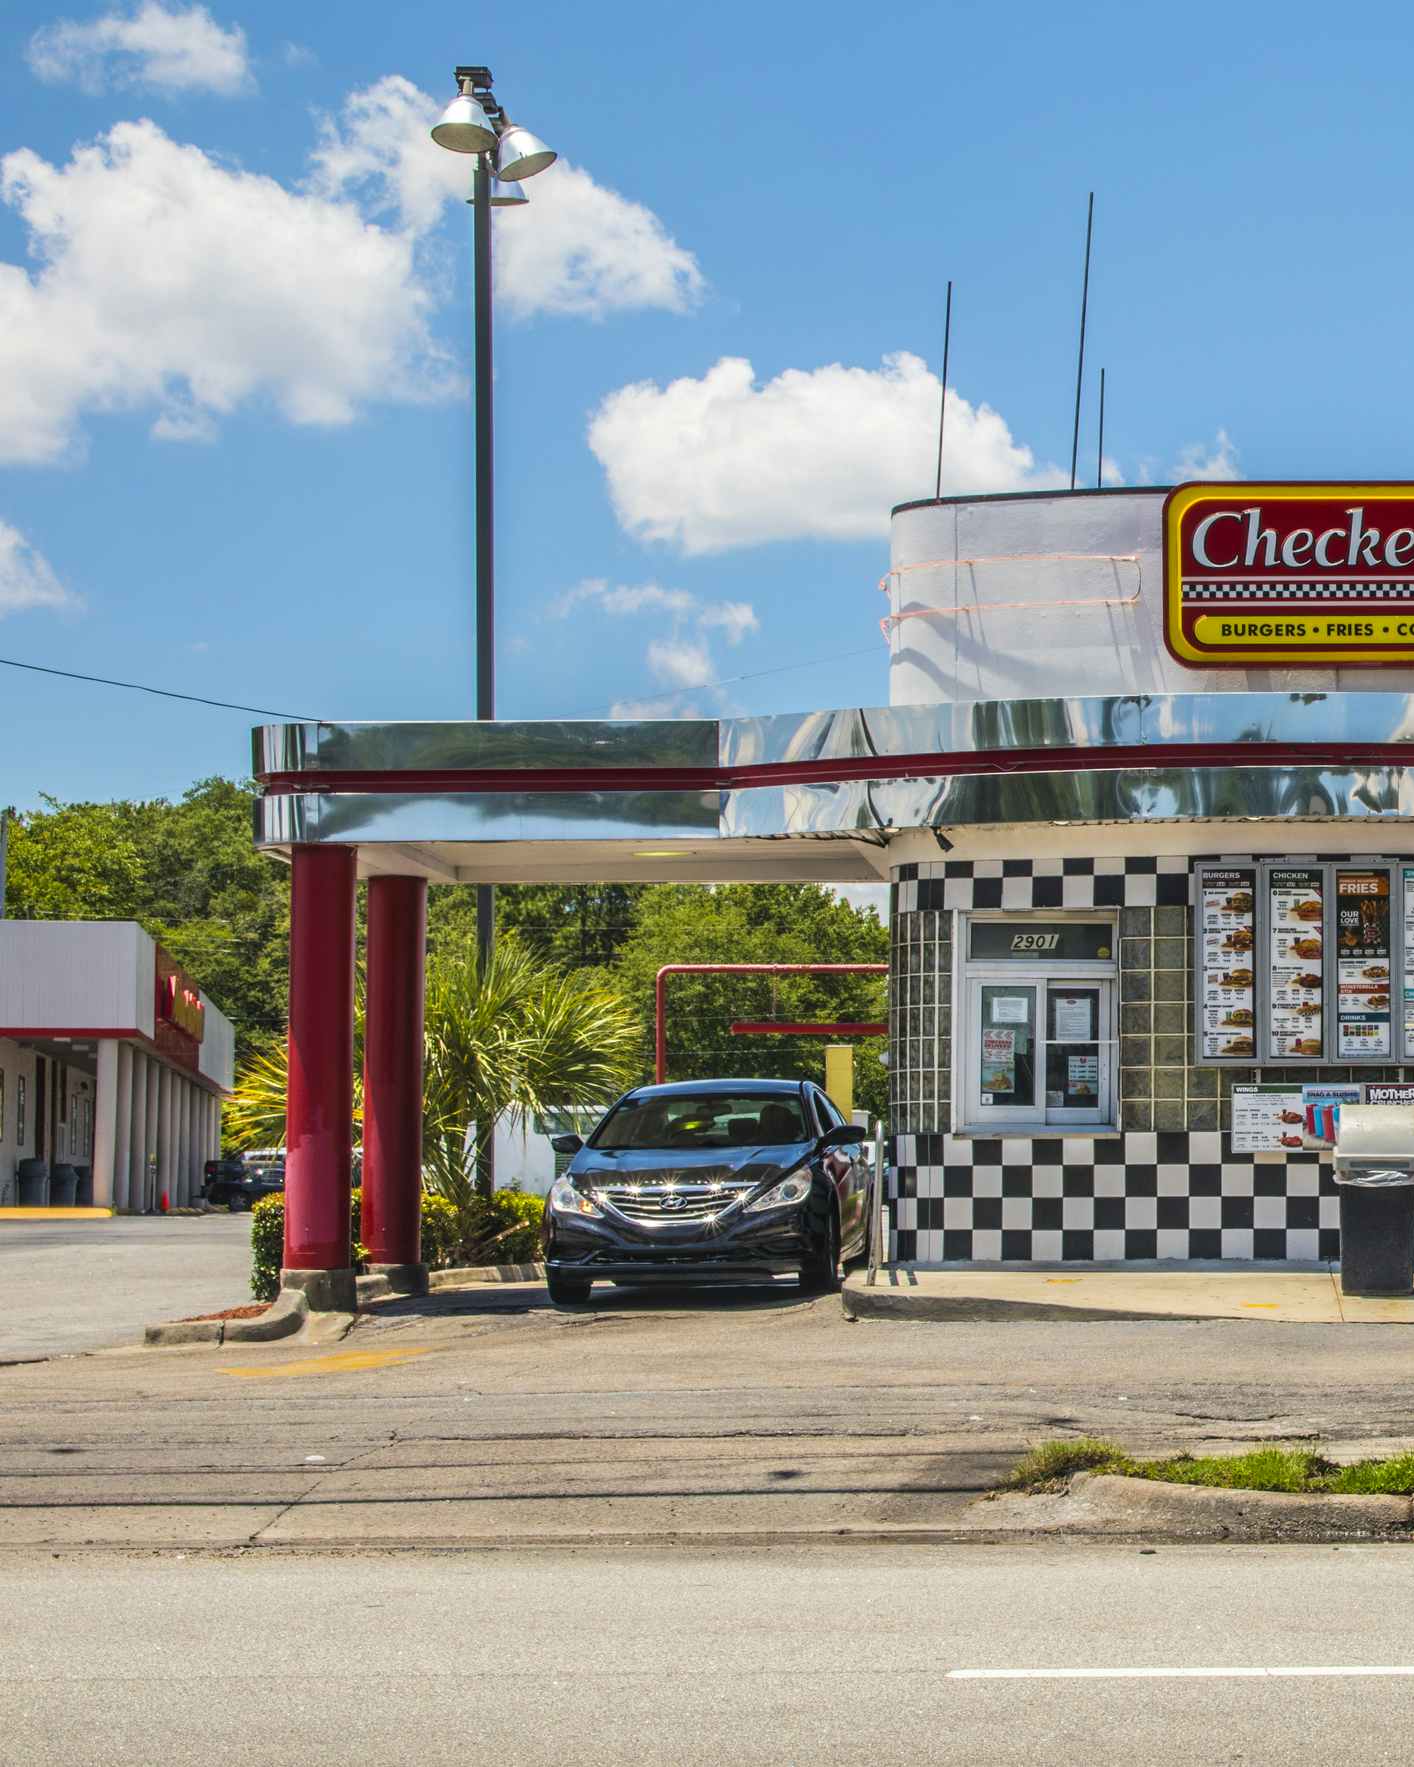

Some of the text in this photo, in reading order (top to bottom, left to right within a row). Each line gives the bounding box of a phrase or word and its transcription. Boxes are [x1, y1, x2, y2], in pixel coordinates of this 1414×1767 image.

[1221, 623, 1306, 637] BURGERS
[1326, 623, 1374, 636] FRIES
[1202, 871, 1241, 880] BURGERS
[1272, 871, 1309, 880] CHICKEN
[1338, 883, 1379, 894] FRIES
[1340, 910, 1360, 919] OUR
[1013, 936, 1055, 949] 2901
